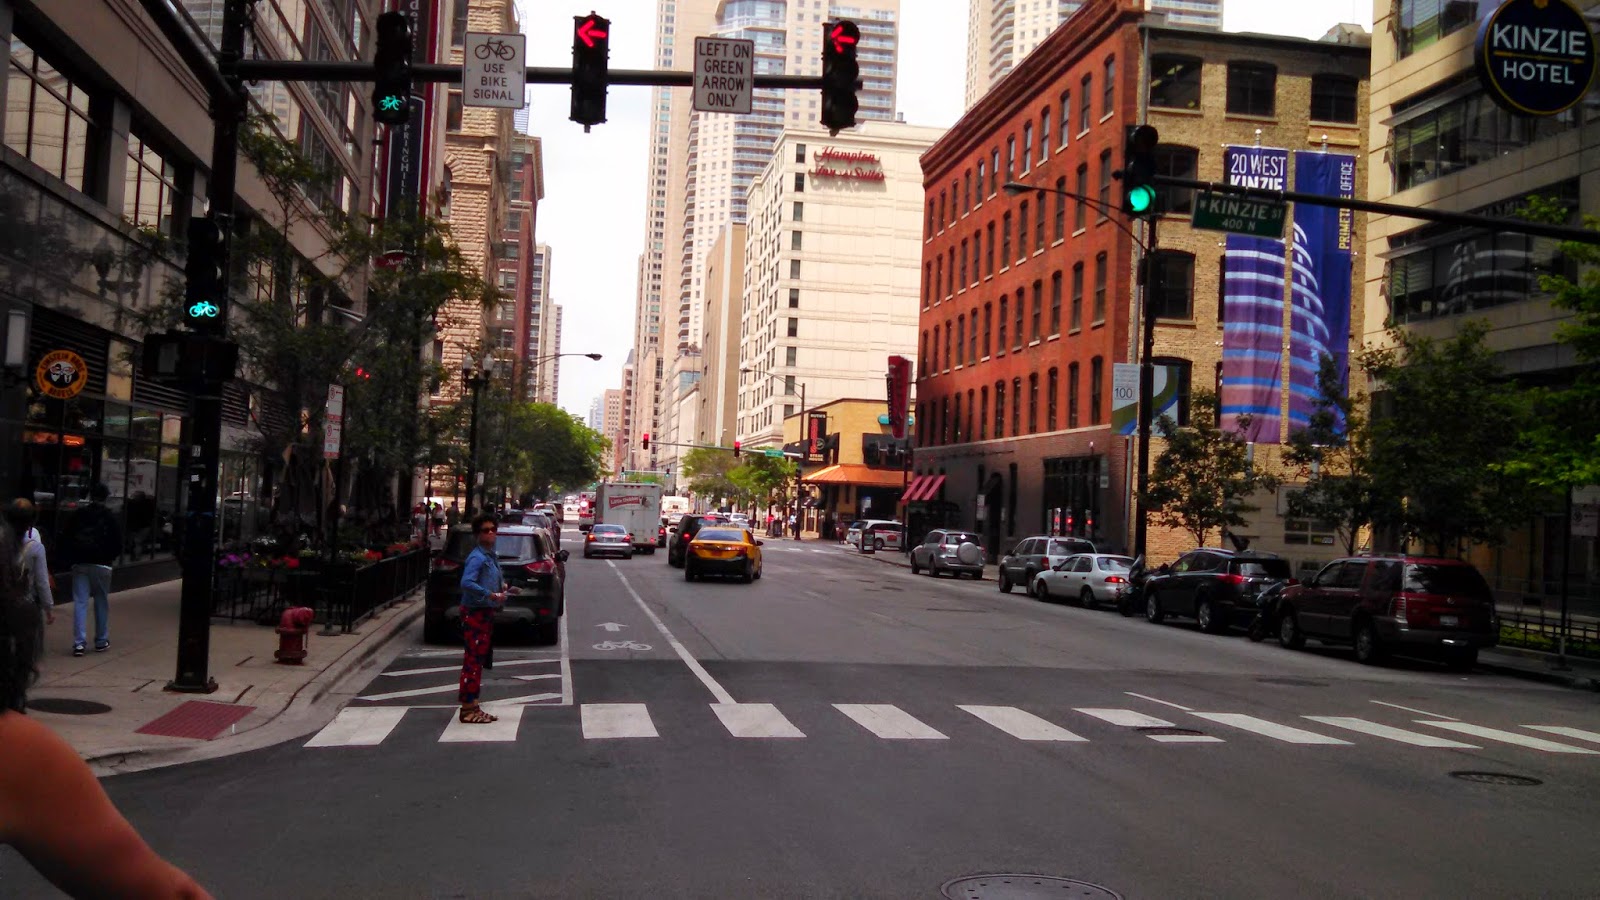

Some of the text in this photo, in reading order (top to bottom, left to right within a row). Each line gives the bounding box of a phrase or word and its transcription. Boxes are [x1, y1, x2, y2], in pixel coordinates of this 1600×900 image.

[1493, 23, 1587, 56] KINZIE
[699, 42, 750, 58] LEFT ON
[484, 63, 506, 74] USE
[704, 58, 744, 75] GREEN
[1503, 60, 1575, 85] HOTEL
[480, 76, 508, 87] BIKE
[702, 75, 745, 91] ARROW
[473, 88, 515, 101] SIGNAL
[708, 92, 738, 107] ONLY
[400, 123, 411, 195] PRINGHILL
[813, 146, 881, 166] Hampton
[808, 165, 836, 178] Inn
[854, 167, 885, 182] Suites
[1230, 153, 1287, 177] 20 WEST
[1199, 199, 1282, 219] W KINZIE ST
[1338, 161, 1354, 249] PRIMETIE OFFICE
[1222, 218, 1256, 231] 400 N
[1114, 387, 1133, 399] 100
